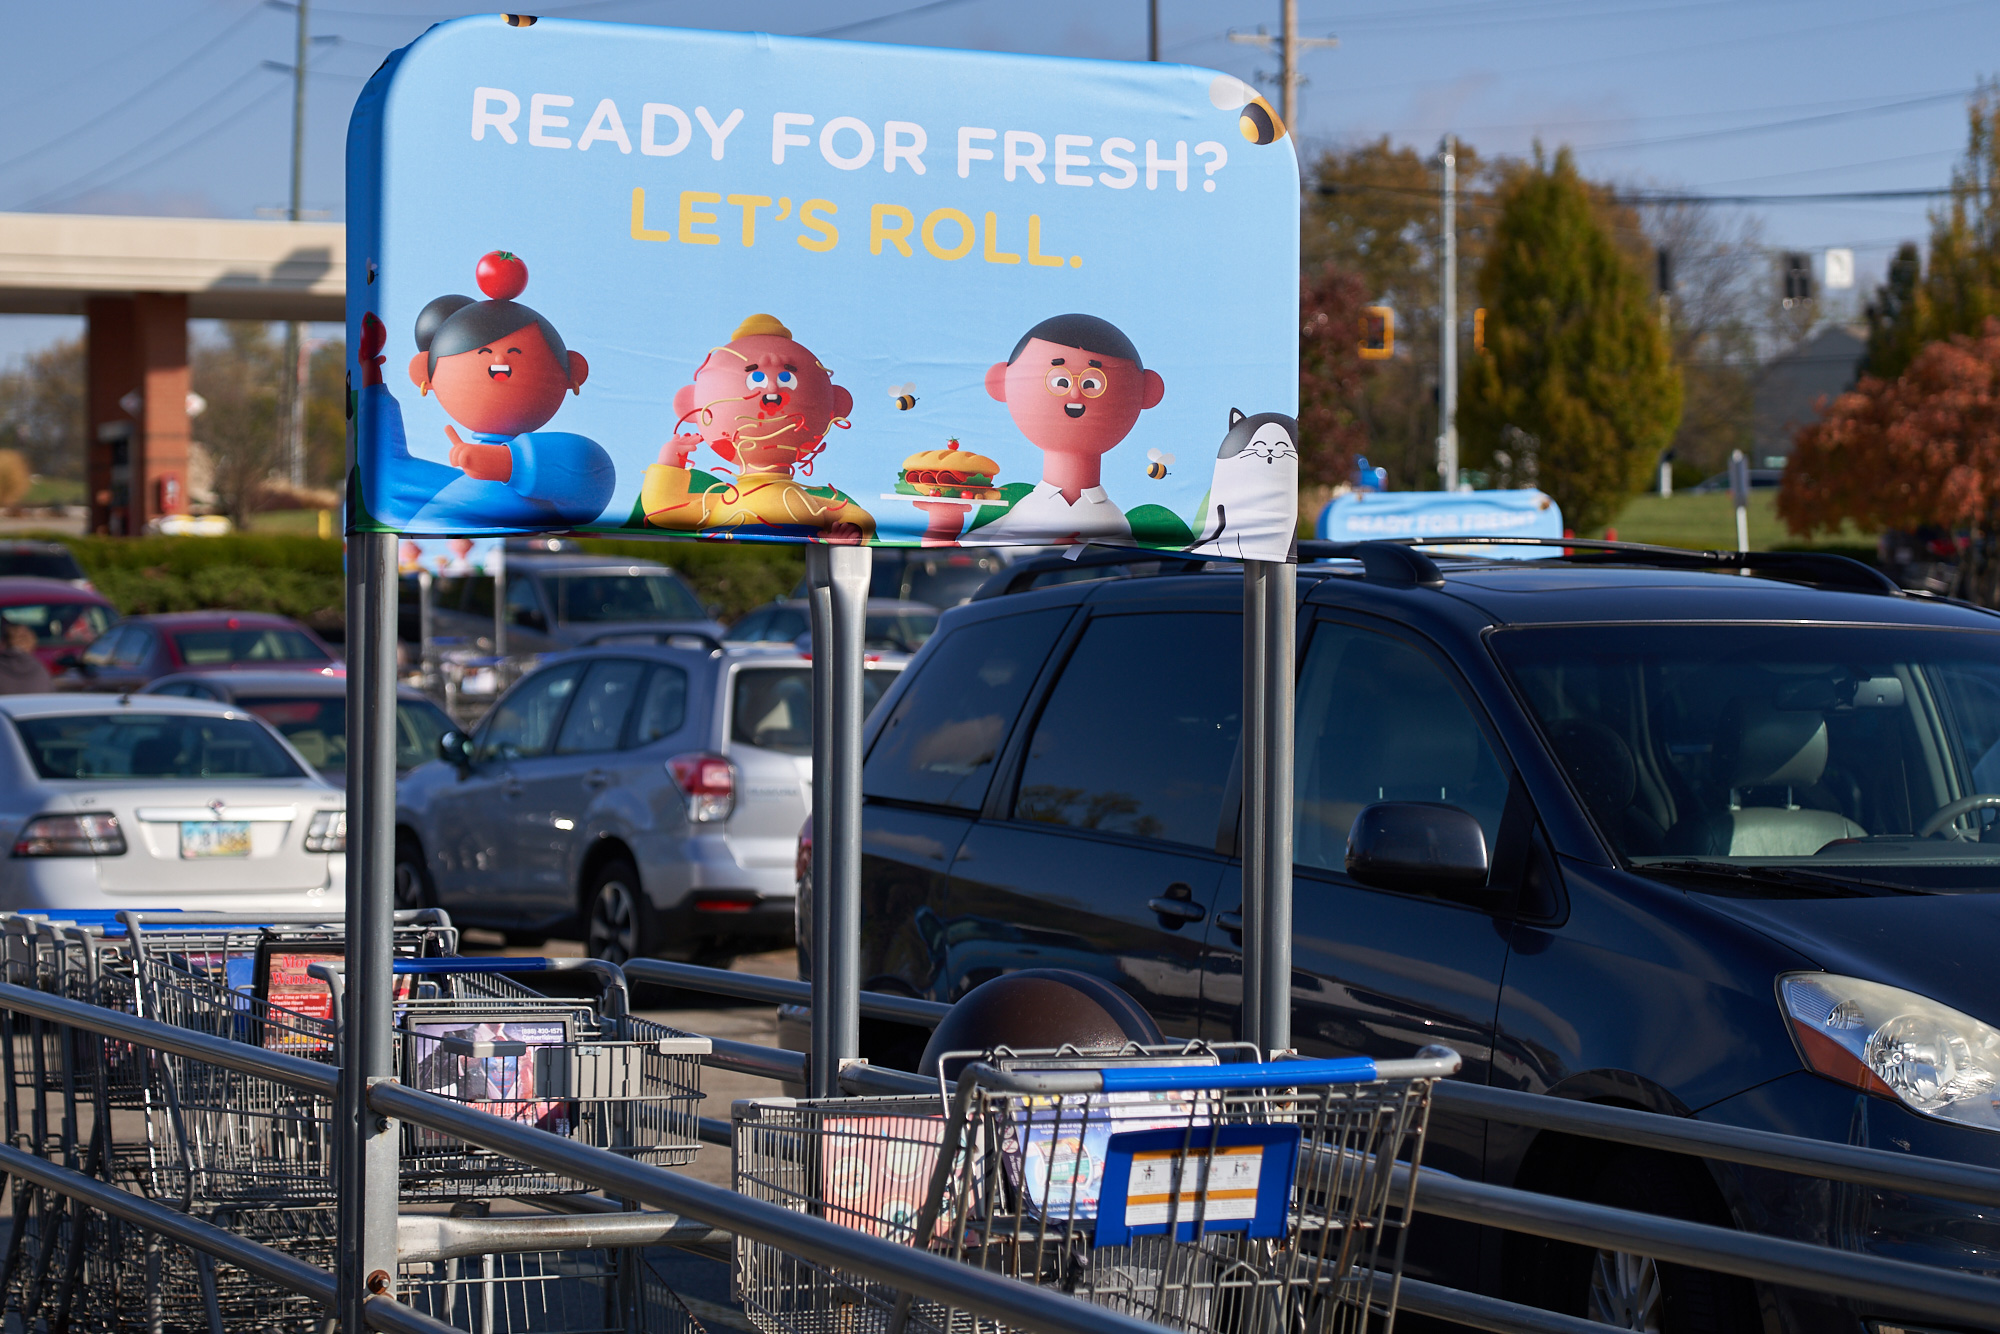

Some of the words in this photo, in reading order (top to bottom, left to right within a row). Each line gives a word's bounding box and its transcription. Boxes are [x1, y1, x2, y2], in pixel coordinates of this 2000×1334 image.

[471, 86, 745, 161] READY
[771, 111, 928, 176] FOR
[957, 126, 1228, 193] FRESH?
[630, 187, 839, 252] LET'S
[869, 203, 1083, 269] ROLL.
[282, 955, 325, 969] Mom
